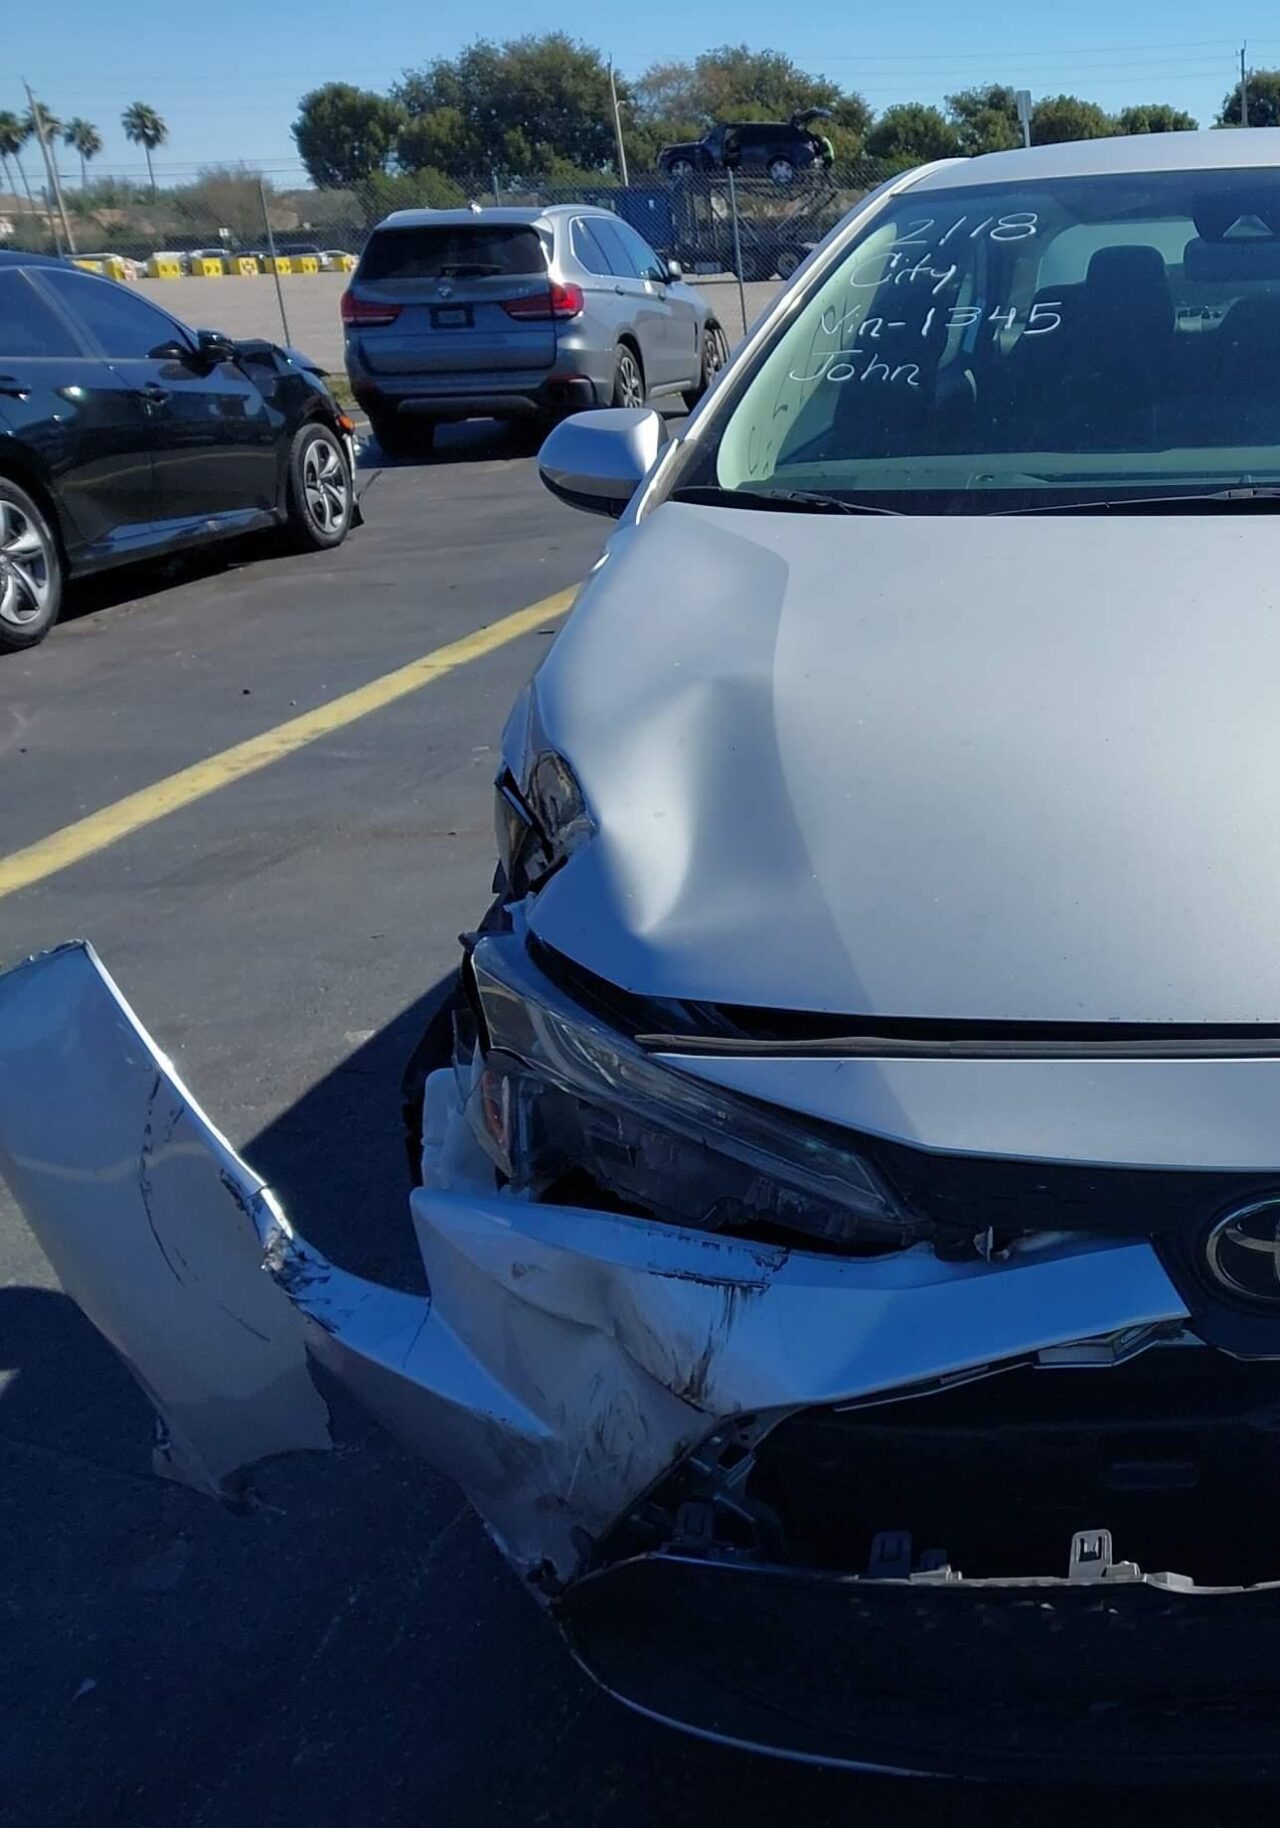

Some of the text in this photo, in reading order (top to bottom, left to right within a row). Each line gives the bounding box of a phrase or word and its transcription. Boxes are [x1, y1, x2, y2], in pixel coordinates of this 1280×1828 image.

[886, 212, 1038, 247] 2118
[850, 252, 958, 295] City
[788, 350, 920, 386] John
